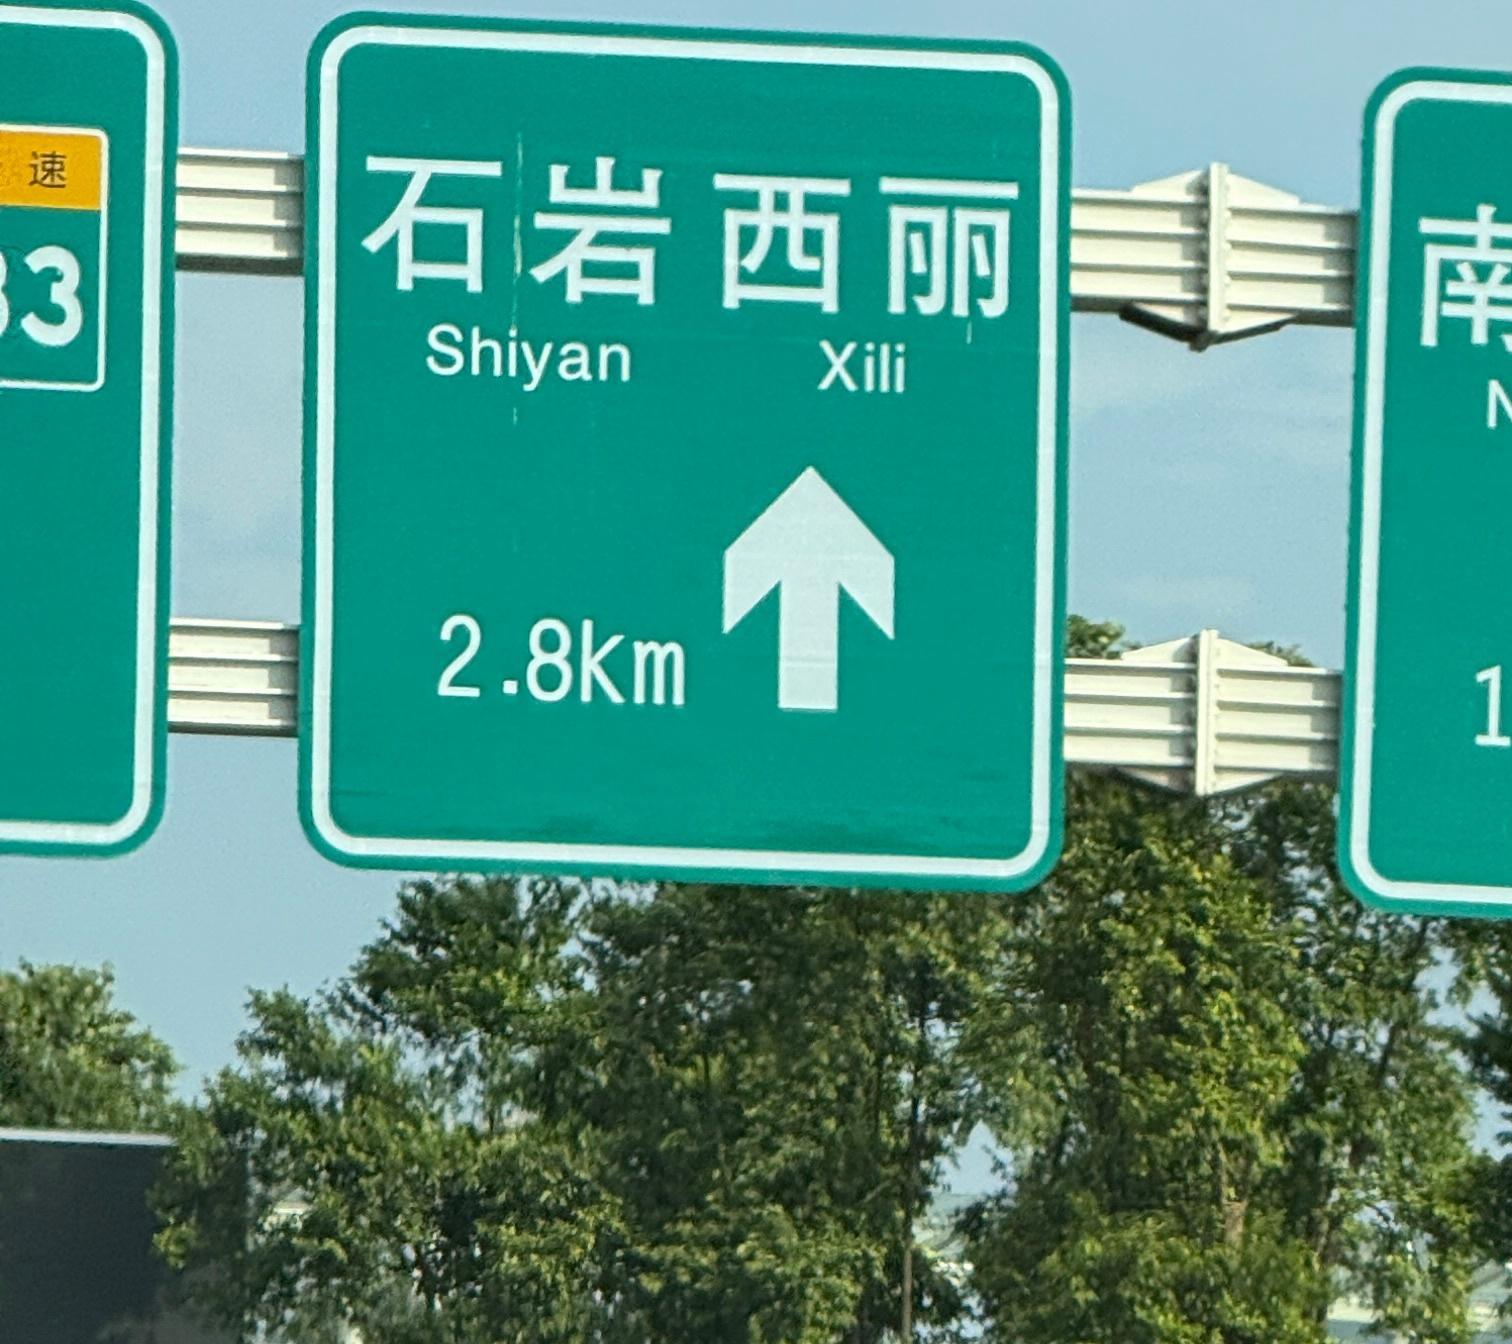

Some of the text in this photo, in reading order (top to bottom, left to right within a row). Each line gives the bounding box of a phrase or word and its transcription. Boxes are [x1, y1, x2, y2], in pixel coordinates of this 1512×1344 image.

[362, 156, 1019, 318] 石岩 西丽
[0, 245, 83, 346] 3
[426, 323, 906, 394] Shiyan Xili
[437, 614, 686, 706] 2.8km
